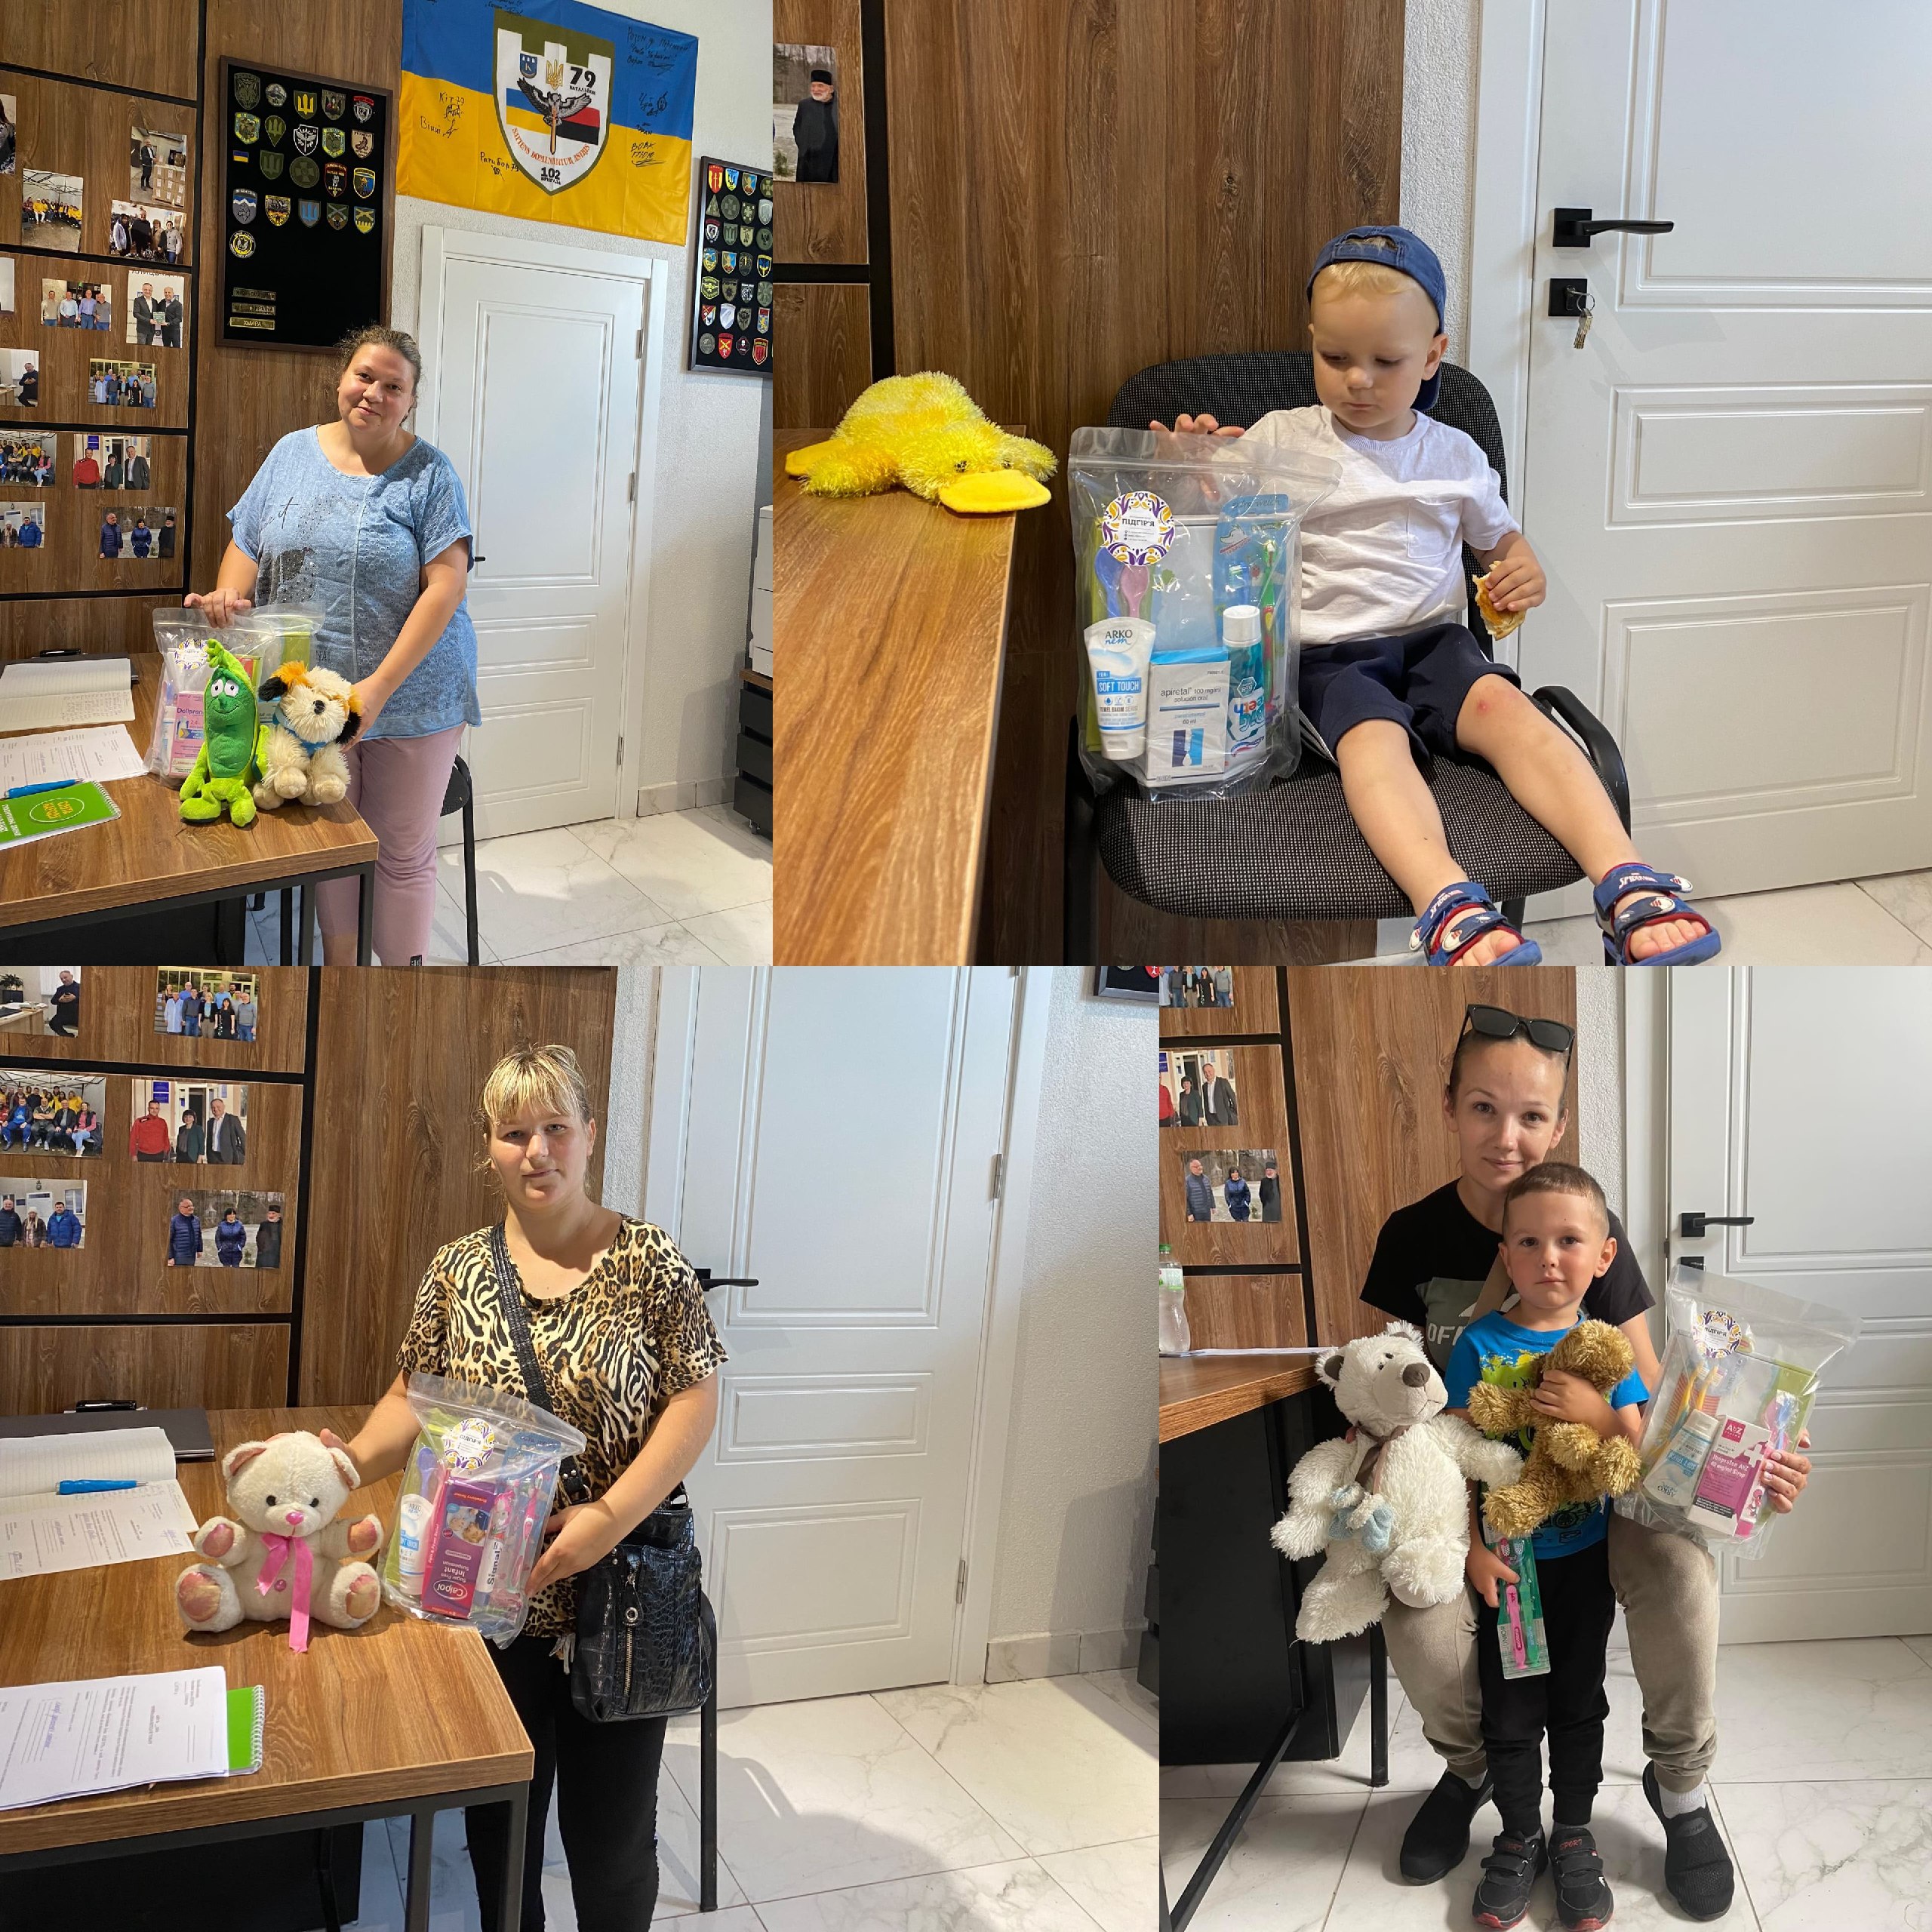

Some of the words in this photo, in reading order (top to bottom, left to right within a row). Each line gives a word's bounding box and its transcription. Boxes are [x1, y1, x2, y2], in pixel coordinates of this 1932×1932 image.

[570, 66, 596, 88] 79
[540, 166, 561, 180] 102
[1121, 518, 1155, 527] ПІДГІР'Я
[1105, 629, 1133, 638] ARKO
[1099, 681, 1115, 692] SOFT
[1117, 680, 1139, 691] TOUCH
[177, 708, 203, 716] Dolipran
[1726, 1424, 1743, 1435] AbZ
[445, 1566, 465, 1577] Infant
[487, 1547, 501, 1586] Signal
[437, 1583, 464, 1597] Calpol
[1500, 1626, 1509, 1652] JUNIOR
